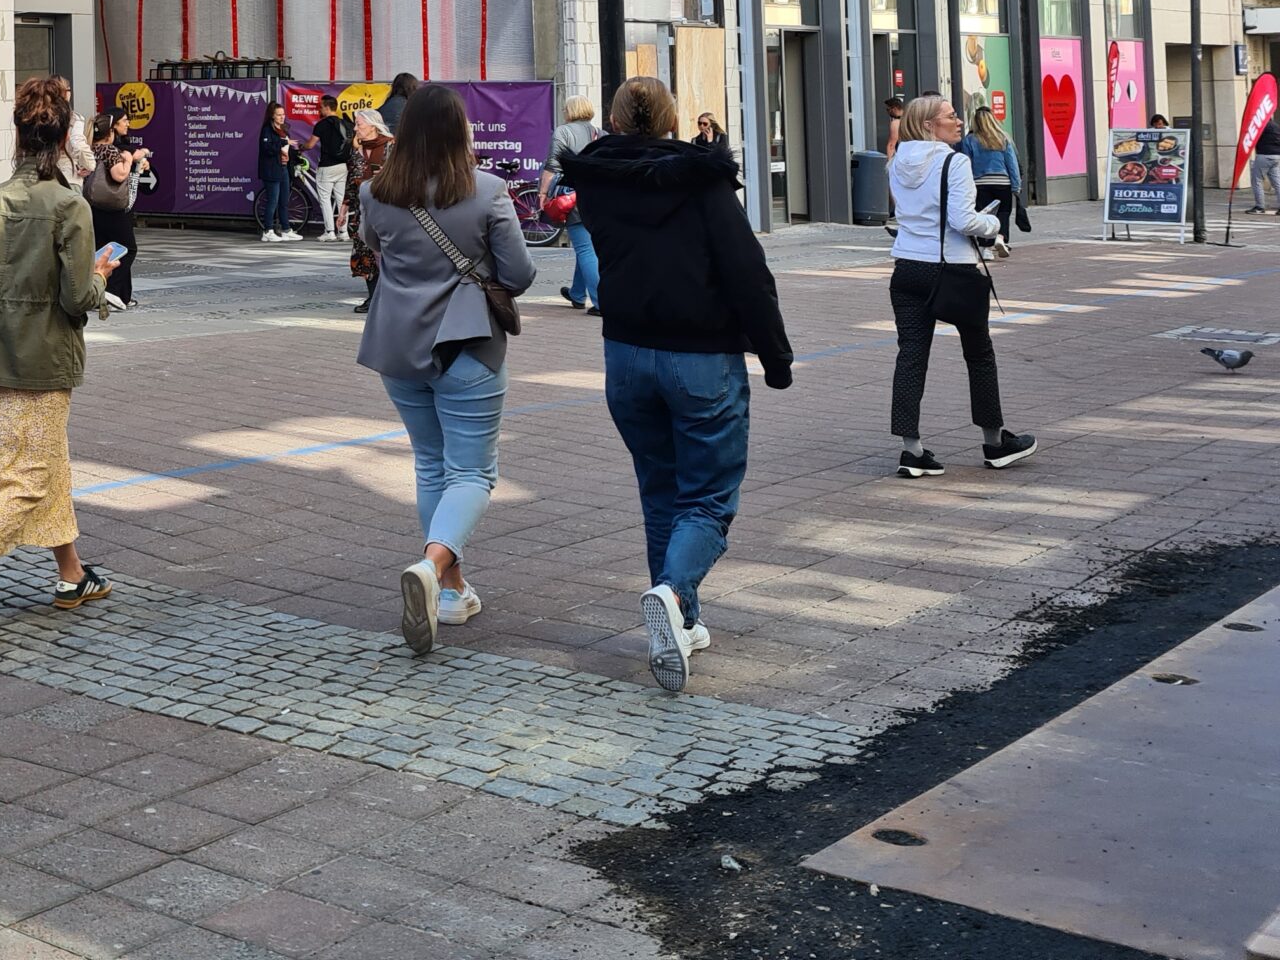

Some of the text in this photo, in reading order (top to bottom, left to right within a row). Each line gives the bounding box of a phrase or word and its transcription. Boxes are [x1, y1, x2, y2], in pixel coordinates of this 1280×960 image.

[291, 94, 319, 103] REWE
[122, 98, 151, 114] NEU-
[340, 98, 372, 112] Große
[488, 123, 507, 132] uns
[1243, 94, 1273, 154] REWE
[188, 176, 207, 184] Bargeld
[1114, 189, 1165, 198] HOTBAR
